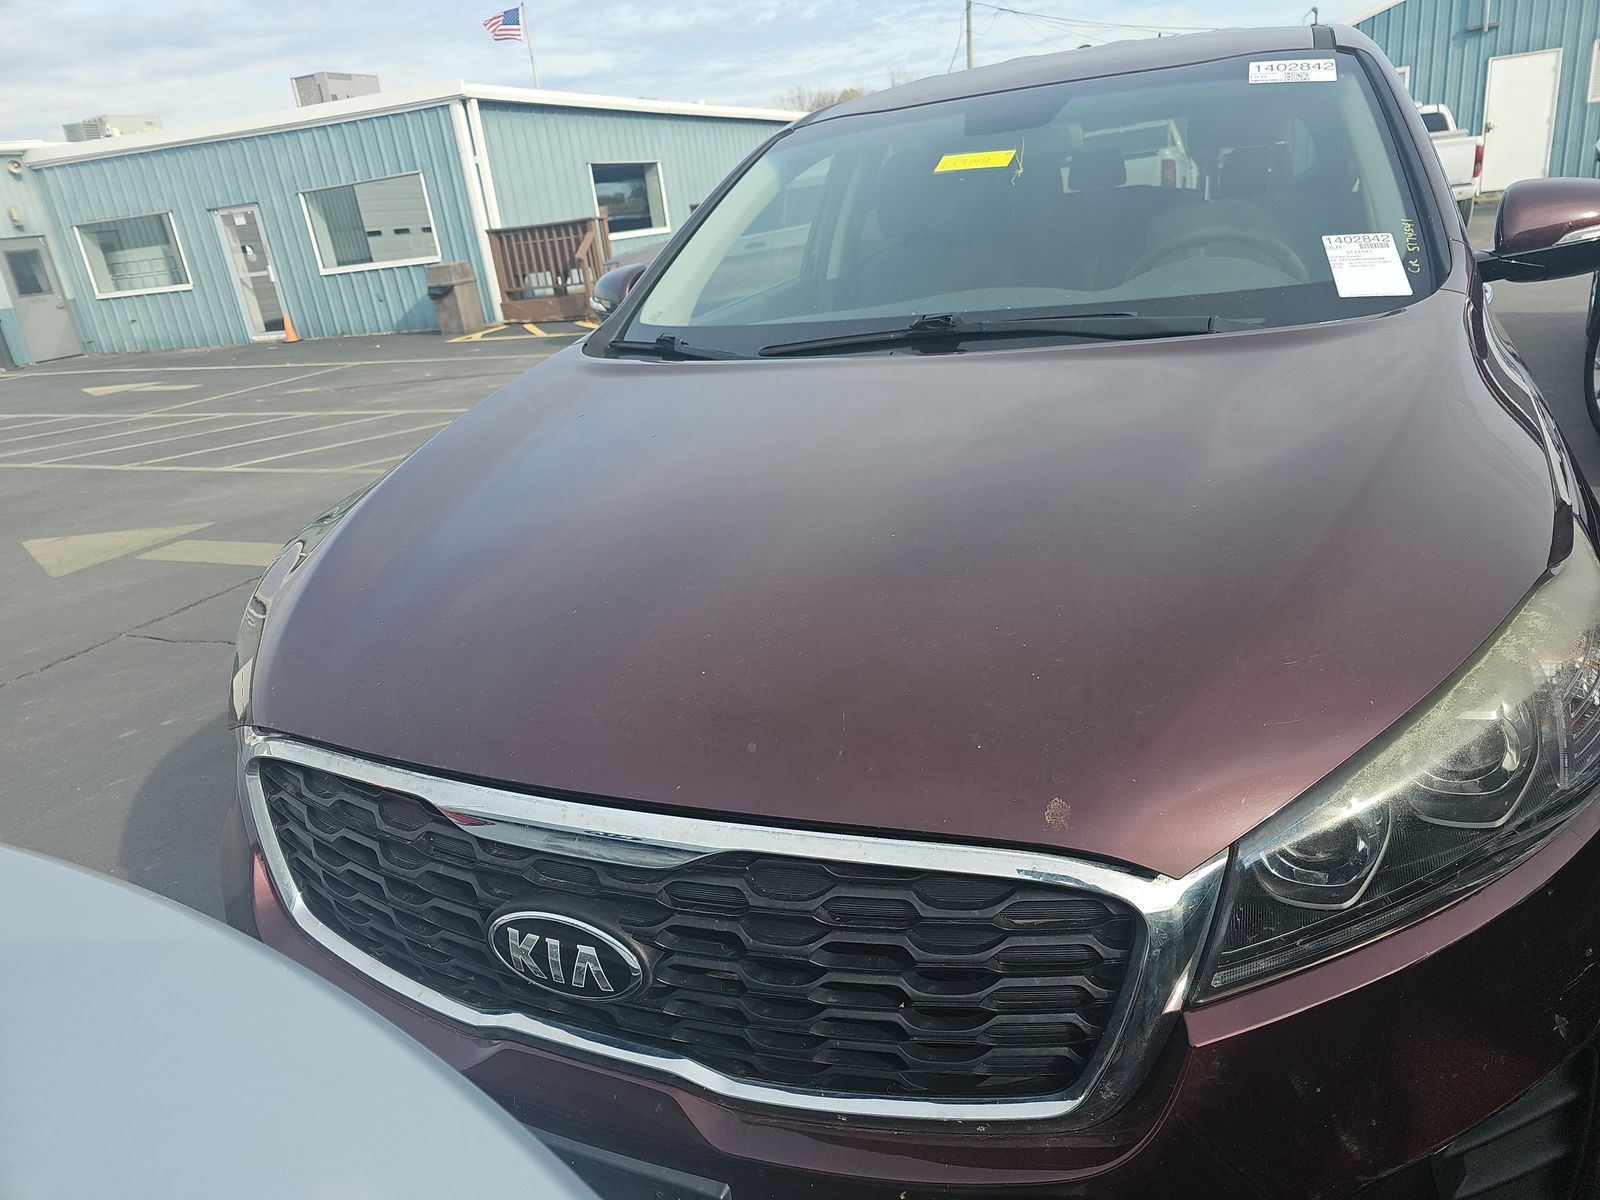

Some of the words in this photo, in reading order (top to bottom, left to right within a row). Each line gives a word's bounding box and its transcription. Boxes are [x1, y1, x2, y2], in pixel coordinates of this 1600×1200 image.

[1255, 62, 1335, 72] 1402842
[1326, 234, 1391, 244] 1402842
[507, 927, 614, 992] KIA
